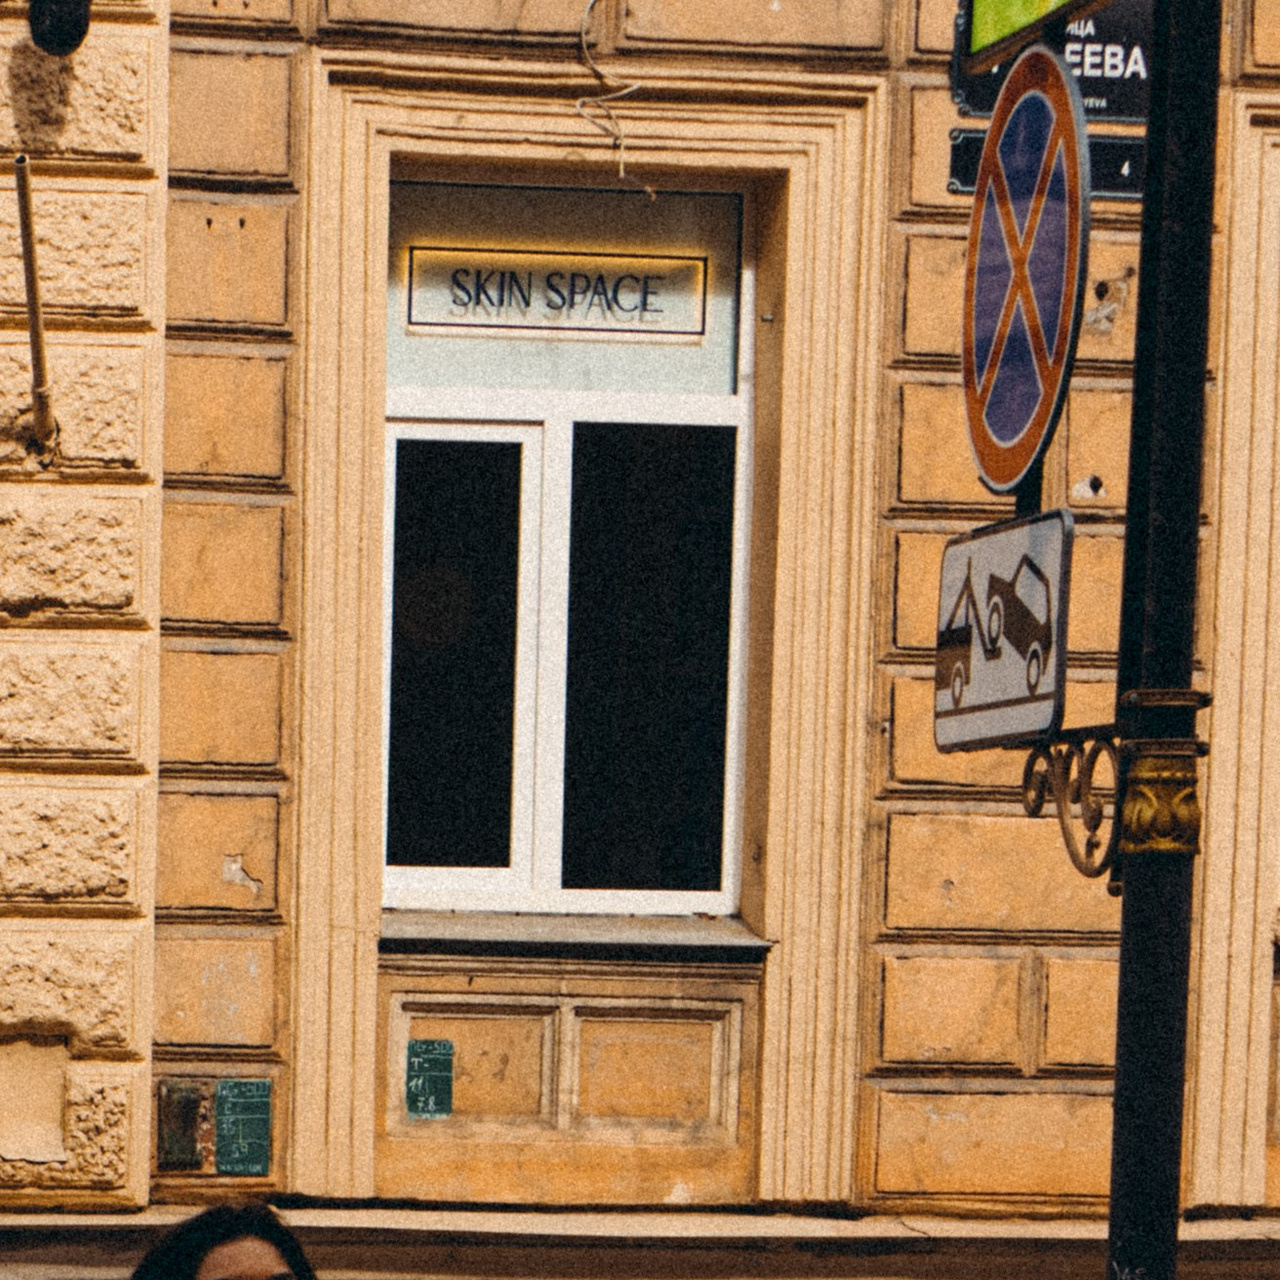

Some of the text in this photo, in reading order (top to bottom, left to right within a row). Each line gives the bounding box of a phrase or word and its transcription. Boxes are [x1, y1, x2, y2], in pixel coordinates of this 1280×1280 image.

[1120, 160, 1131, 177] 4
[451, 268, 666, 314] SKIN SPACE
